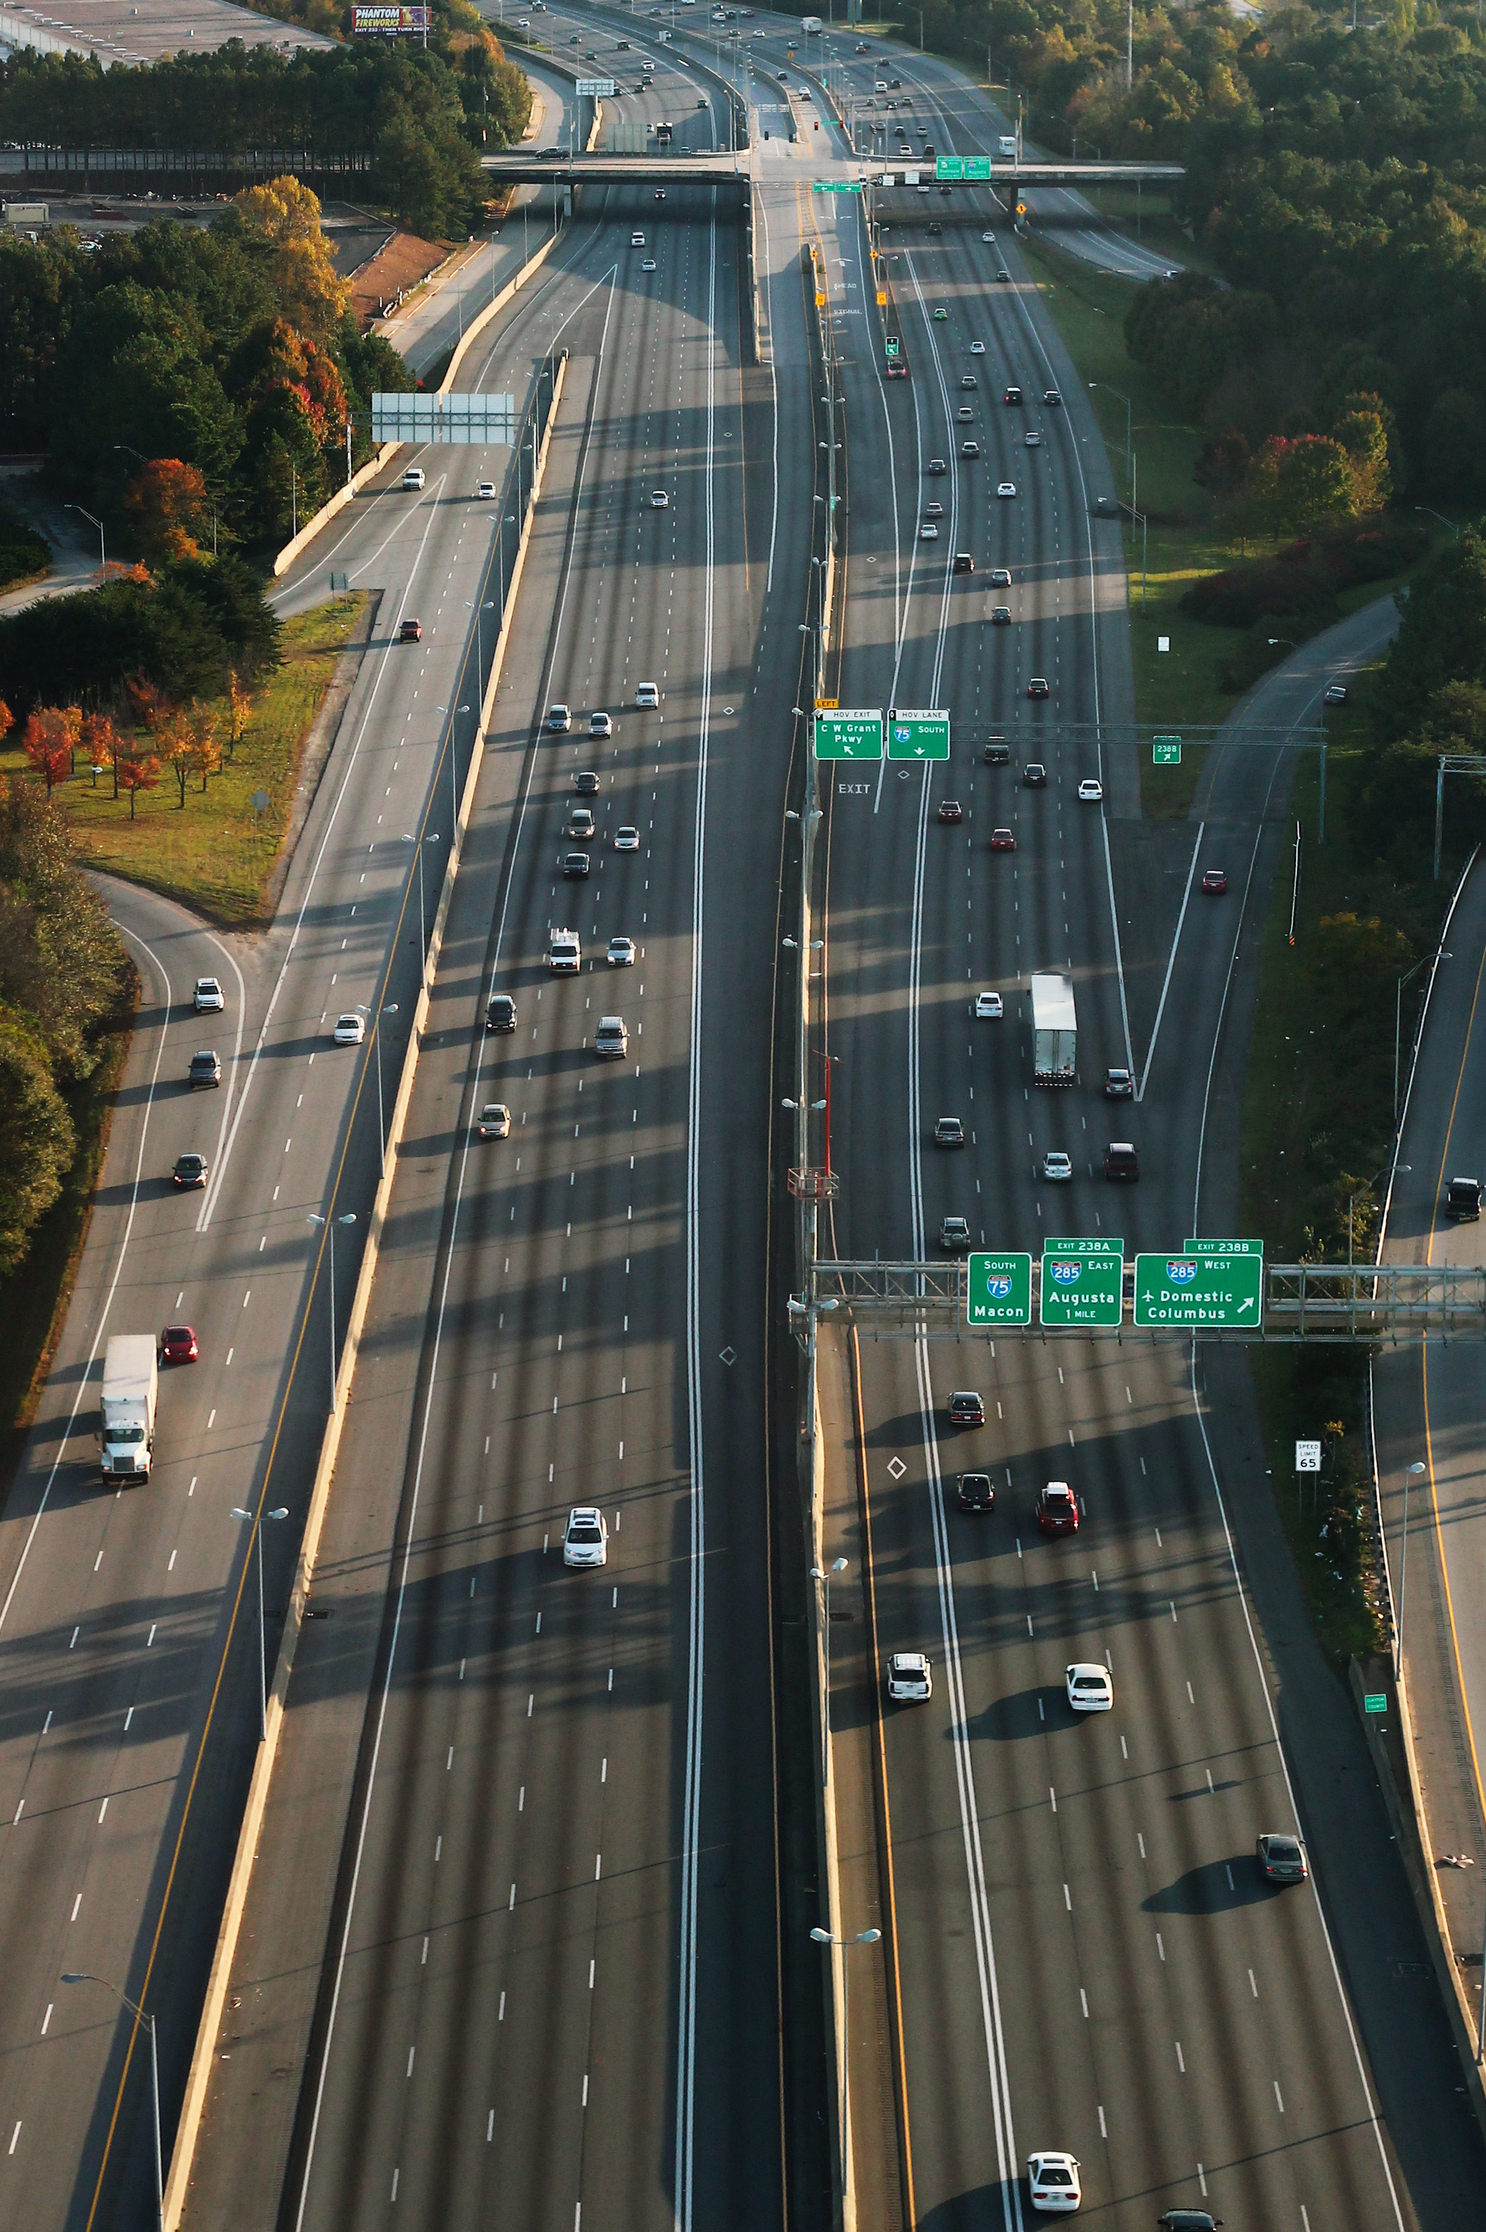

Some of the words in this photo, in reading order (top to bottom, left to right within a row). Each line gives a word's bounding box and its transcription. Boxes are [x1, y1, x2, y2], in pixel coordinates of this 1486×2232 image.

[356, 8, 400, 18] PHANTOM
[835, 735, 862, 744] Pkwy
[896, 730, 909, 739] 75
[838, 784, 870, 794] EXIT
[1079, 1242, 1110, 1250] 238A
[1218, 1243, 1249, 1252] 238B
[984, 1261, 1016, 1269] SOUTH
[1055, 1268, 1079, 1279] 285
[1088, 1261, 1114, 1269] EAST
[1170, 1267, 1194, 1278] 285
[1205, 1261, 1231, 1269] WEST
[990, 1281, 1008, 1294] 75
[1049, 1292, 1114, 1306] Augusta
[1161, 1291, 1232, 1302] Domestic
[975, 1306, 1023, 1316] Macon
[1066, 1310, 1070, 1319] 1
[1148, 1308, 1225, 1318] Columbus
[1300, 1459, 1316, 1467] 65
